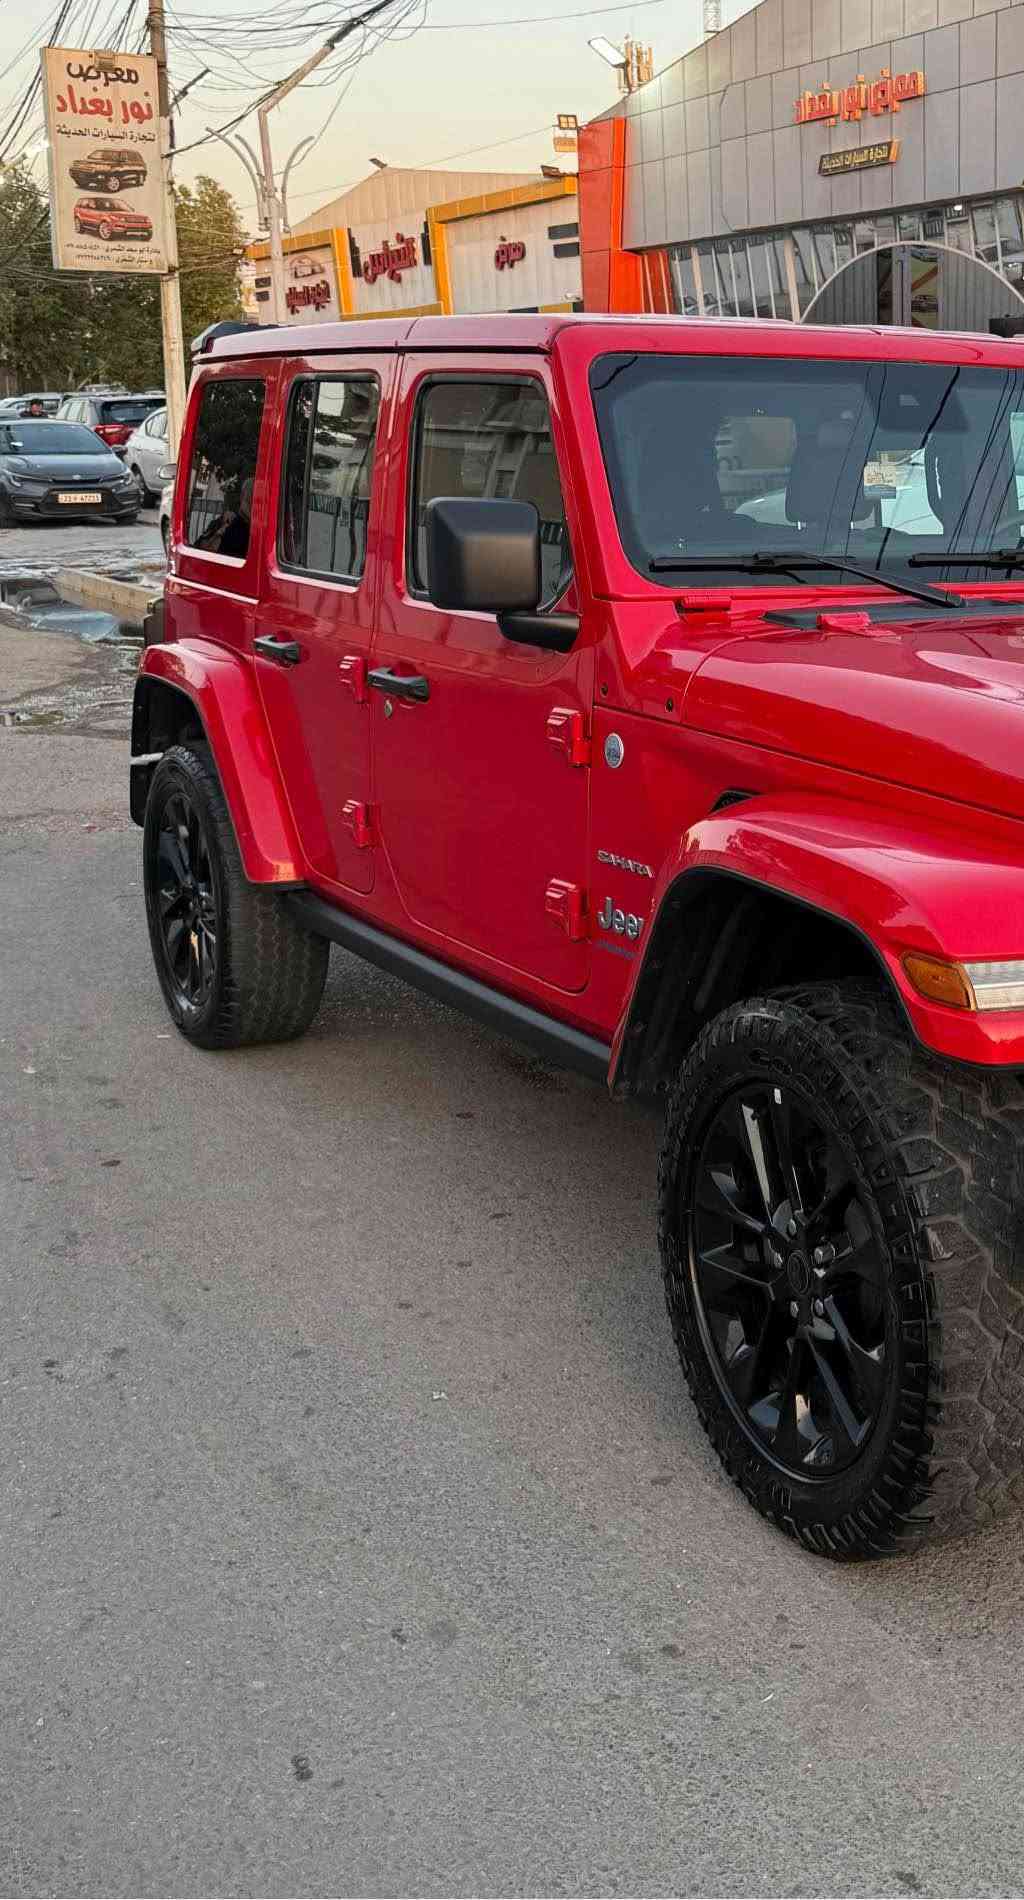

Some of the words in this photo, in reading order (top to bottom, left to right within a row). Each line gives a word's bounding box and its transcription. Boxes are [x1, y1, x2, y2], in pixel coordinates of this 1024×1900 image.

[67, 54, 139, 87] معرض
[56, 84, 113, 122] بغداد
[121, 91, 153, 124] نور
[793, 82, 840, 127] بغداد
[840, 74, 867, 121] نور
[868, 68, 925, 116] معرض
[92, 127, 128, 142] السيارات
